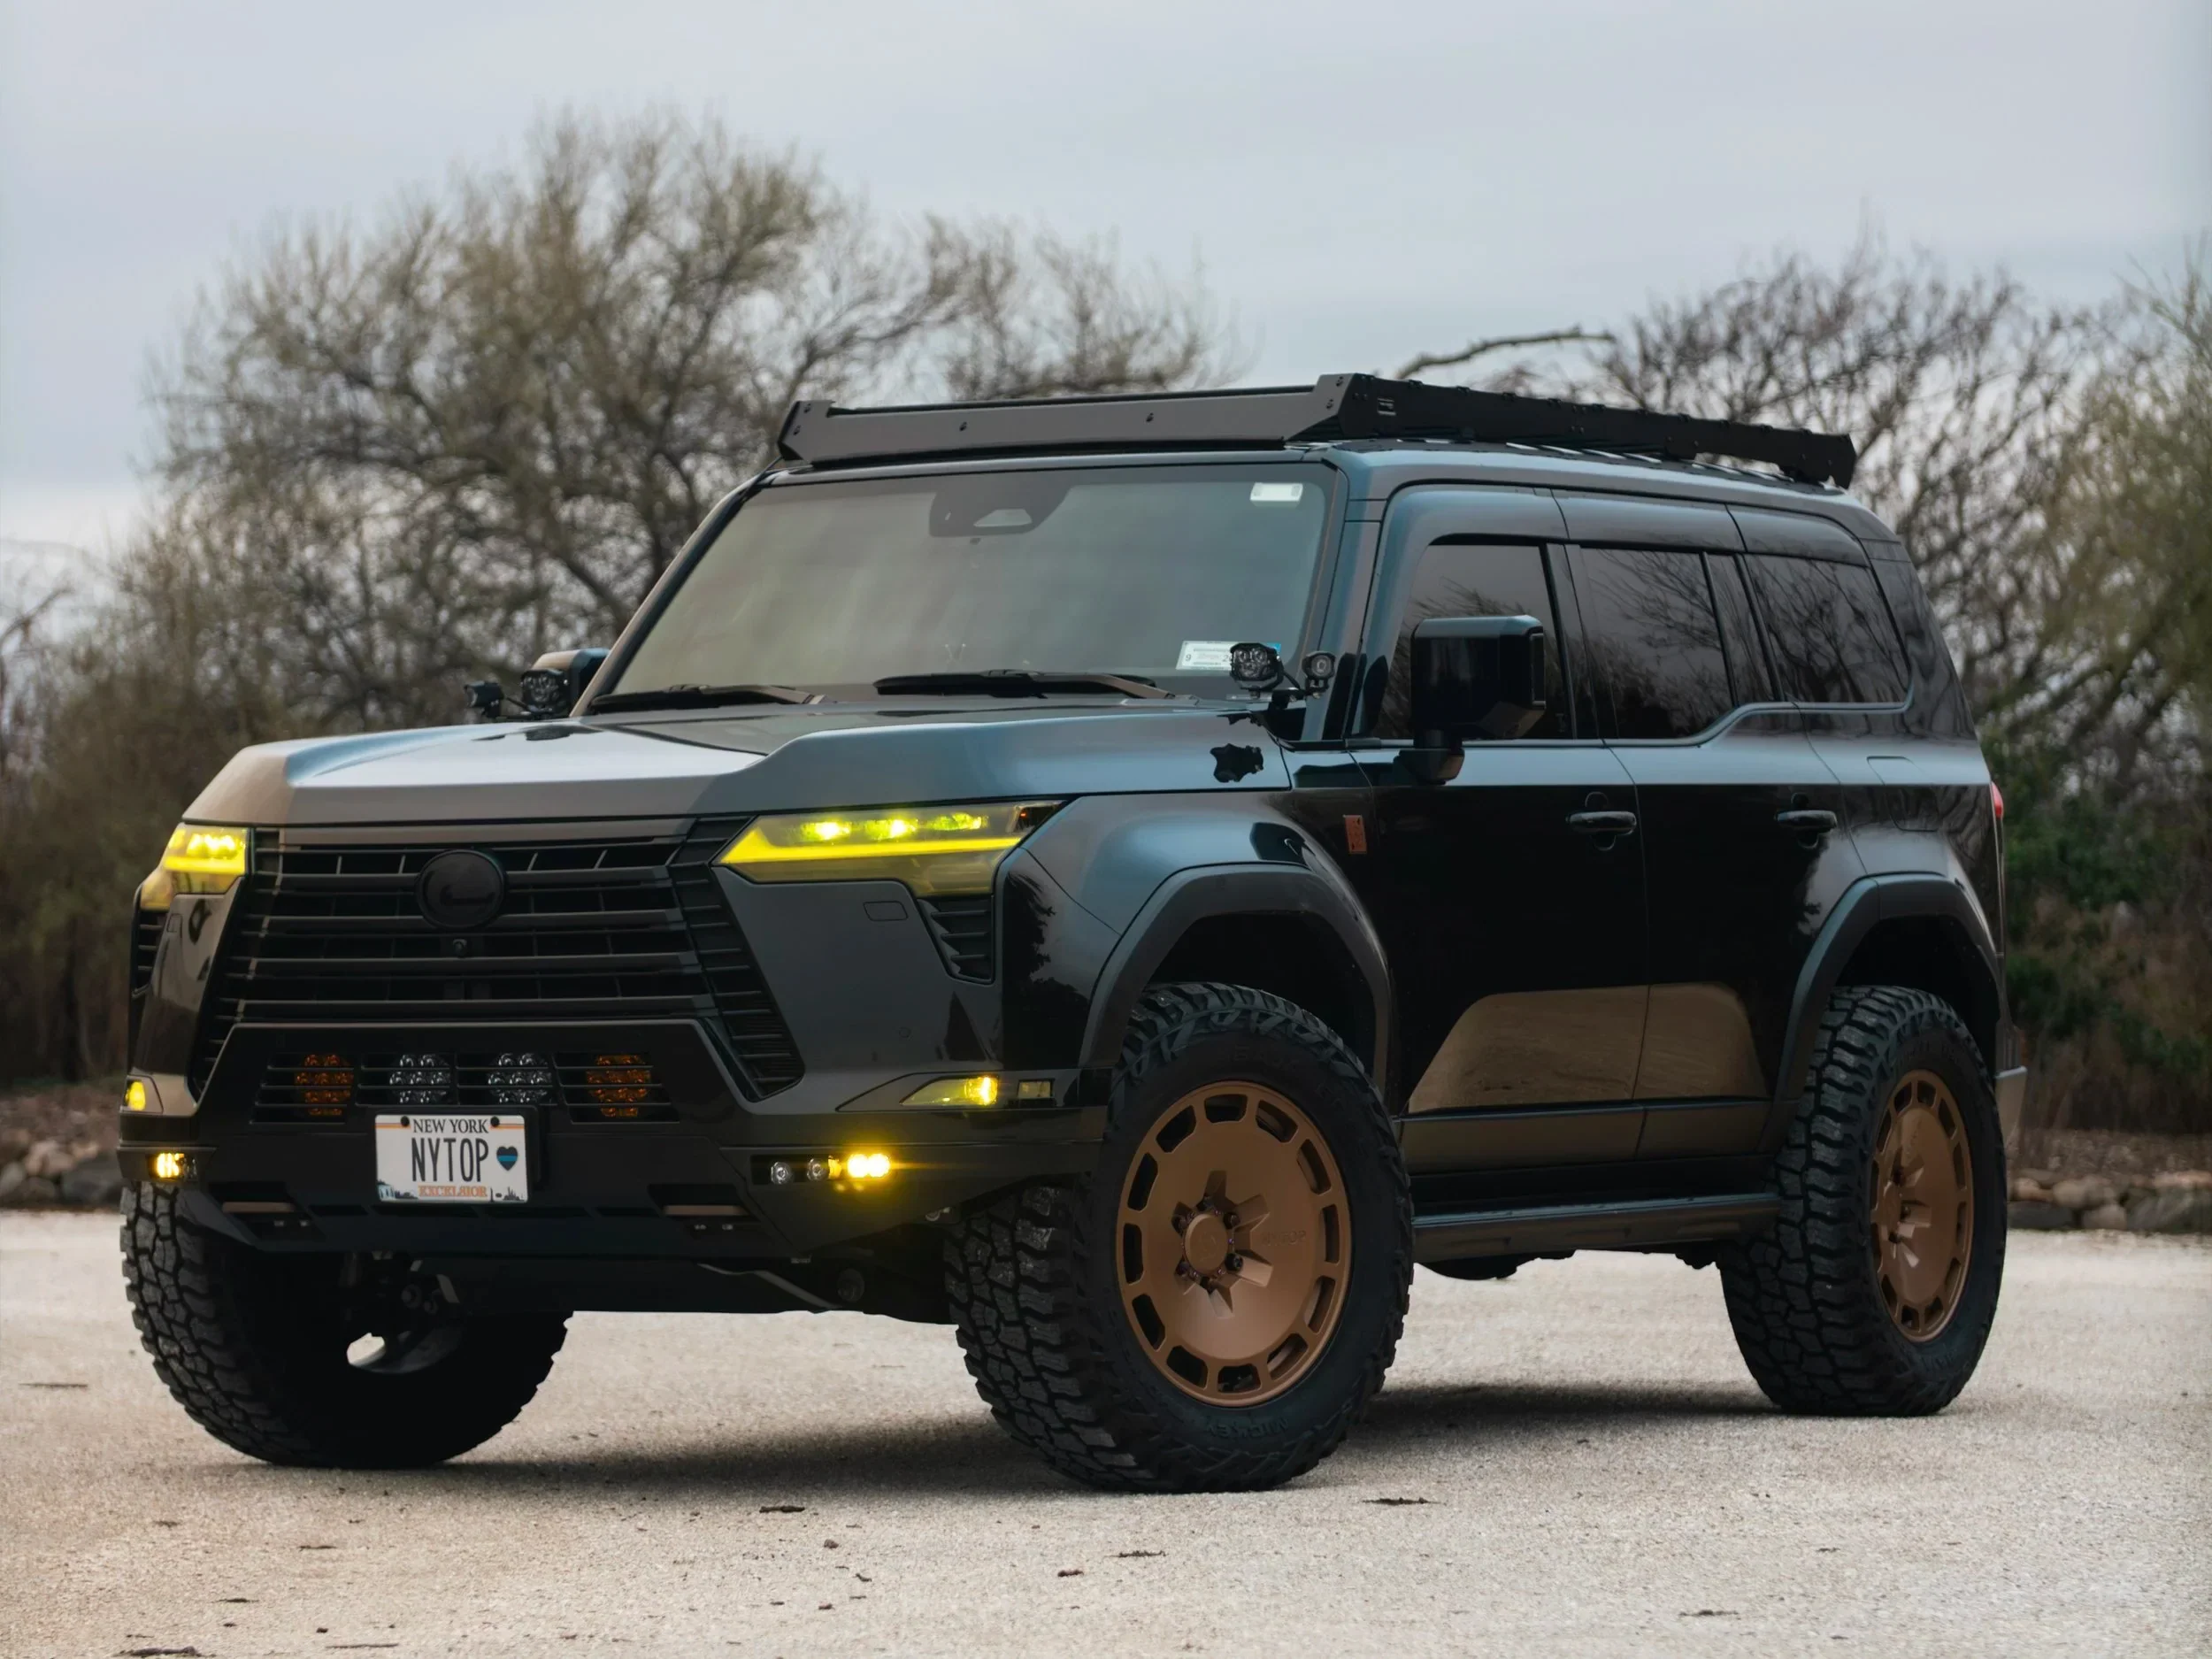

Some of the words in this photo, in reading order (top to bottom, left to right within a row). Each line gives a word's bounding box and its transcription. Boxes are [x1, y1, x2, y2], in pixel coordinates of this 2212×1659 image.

[413, 1118, 447, 1133] NEW
[449, 1118, 489, 1133] YORK
[411, 1137, 489, 1182] NYTOP
[418, 1185, 488, 1198] EXCELSIOR
